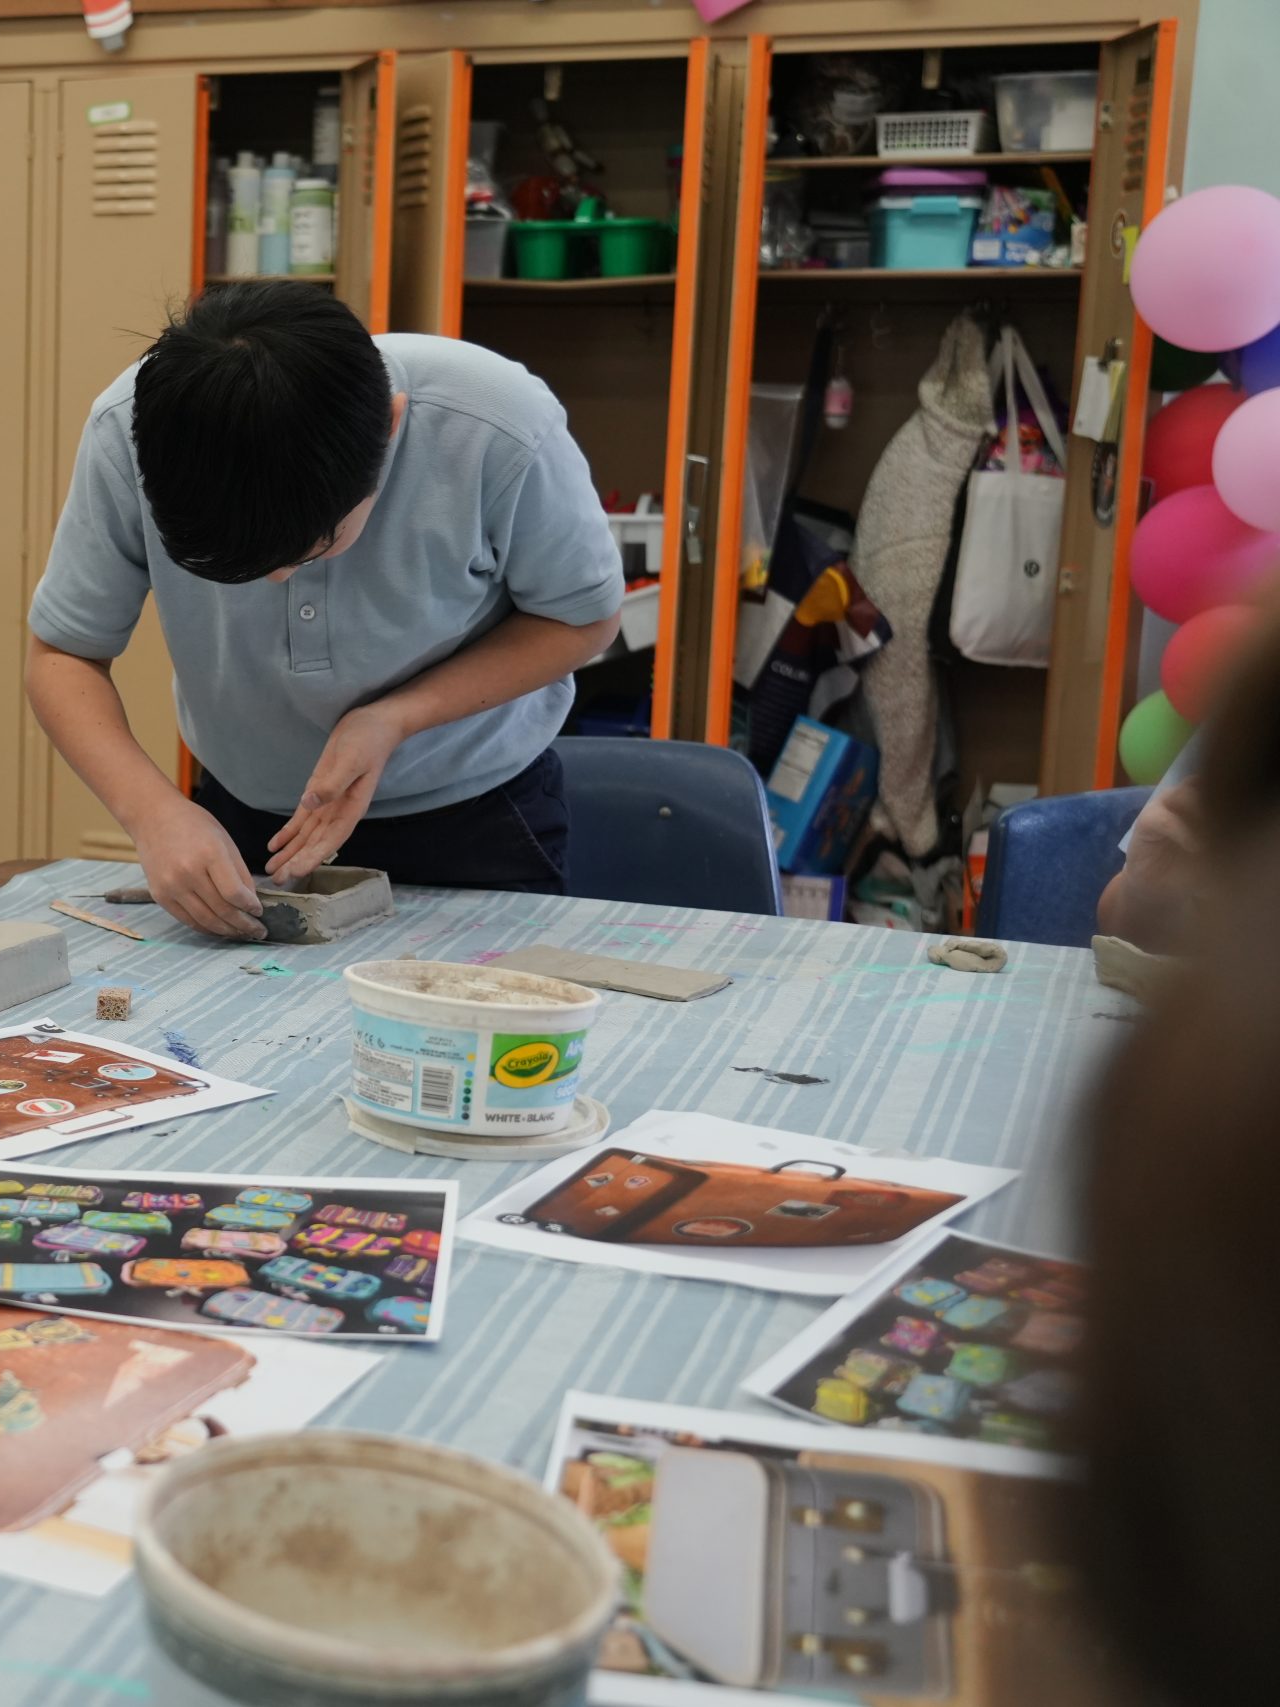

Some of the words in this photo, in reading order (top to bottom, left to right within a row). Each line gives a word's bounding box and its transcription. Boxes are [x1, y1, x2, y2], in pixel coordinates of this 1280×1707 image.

[507, 1051, 551, 1070] Crayola
[484, 1112, 521, 1123] WHITE
[527, 1112, 556, 1123] BLANC
